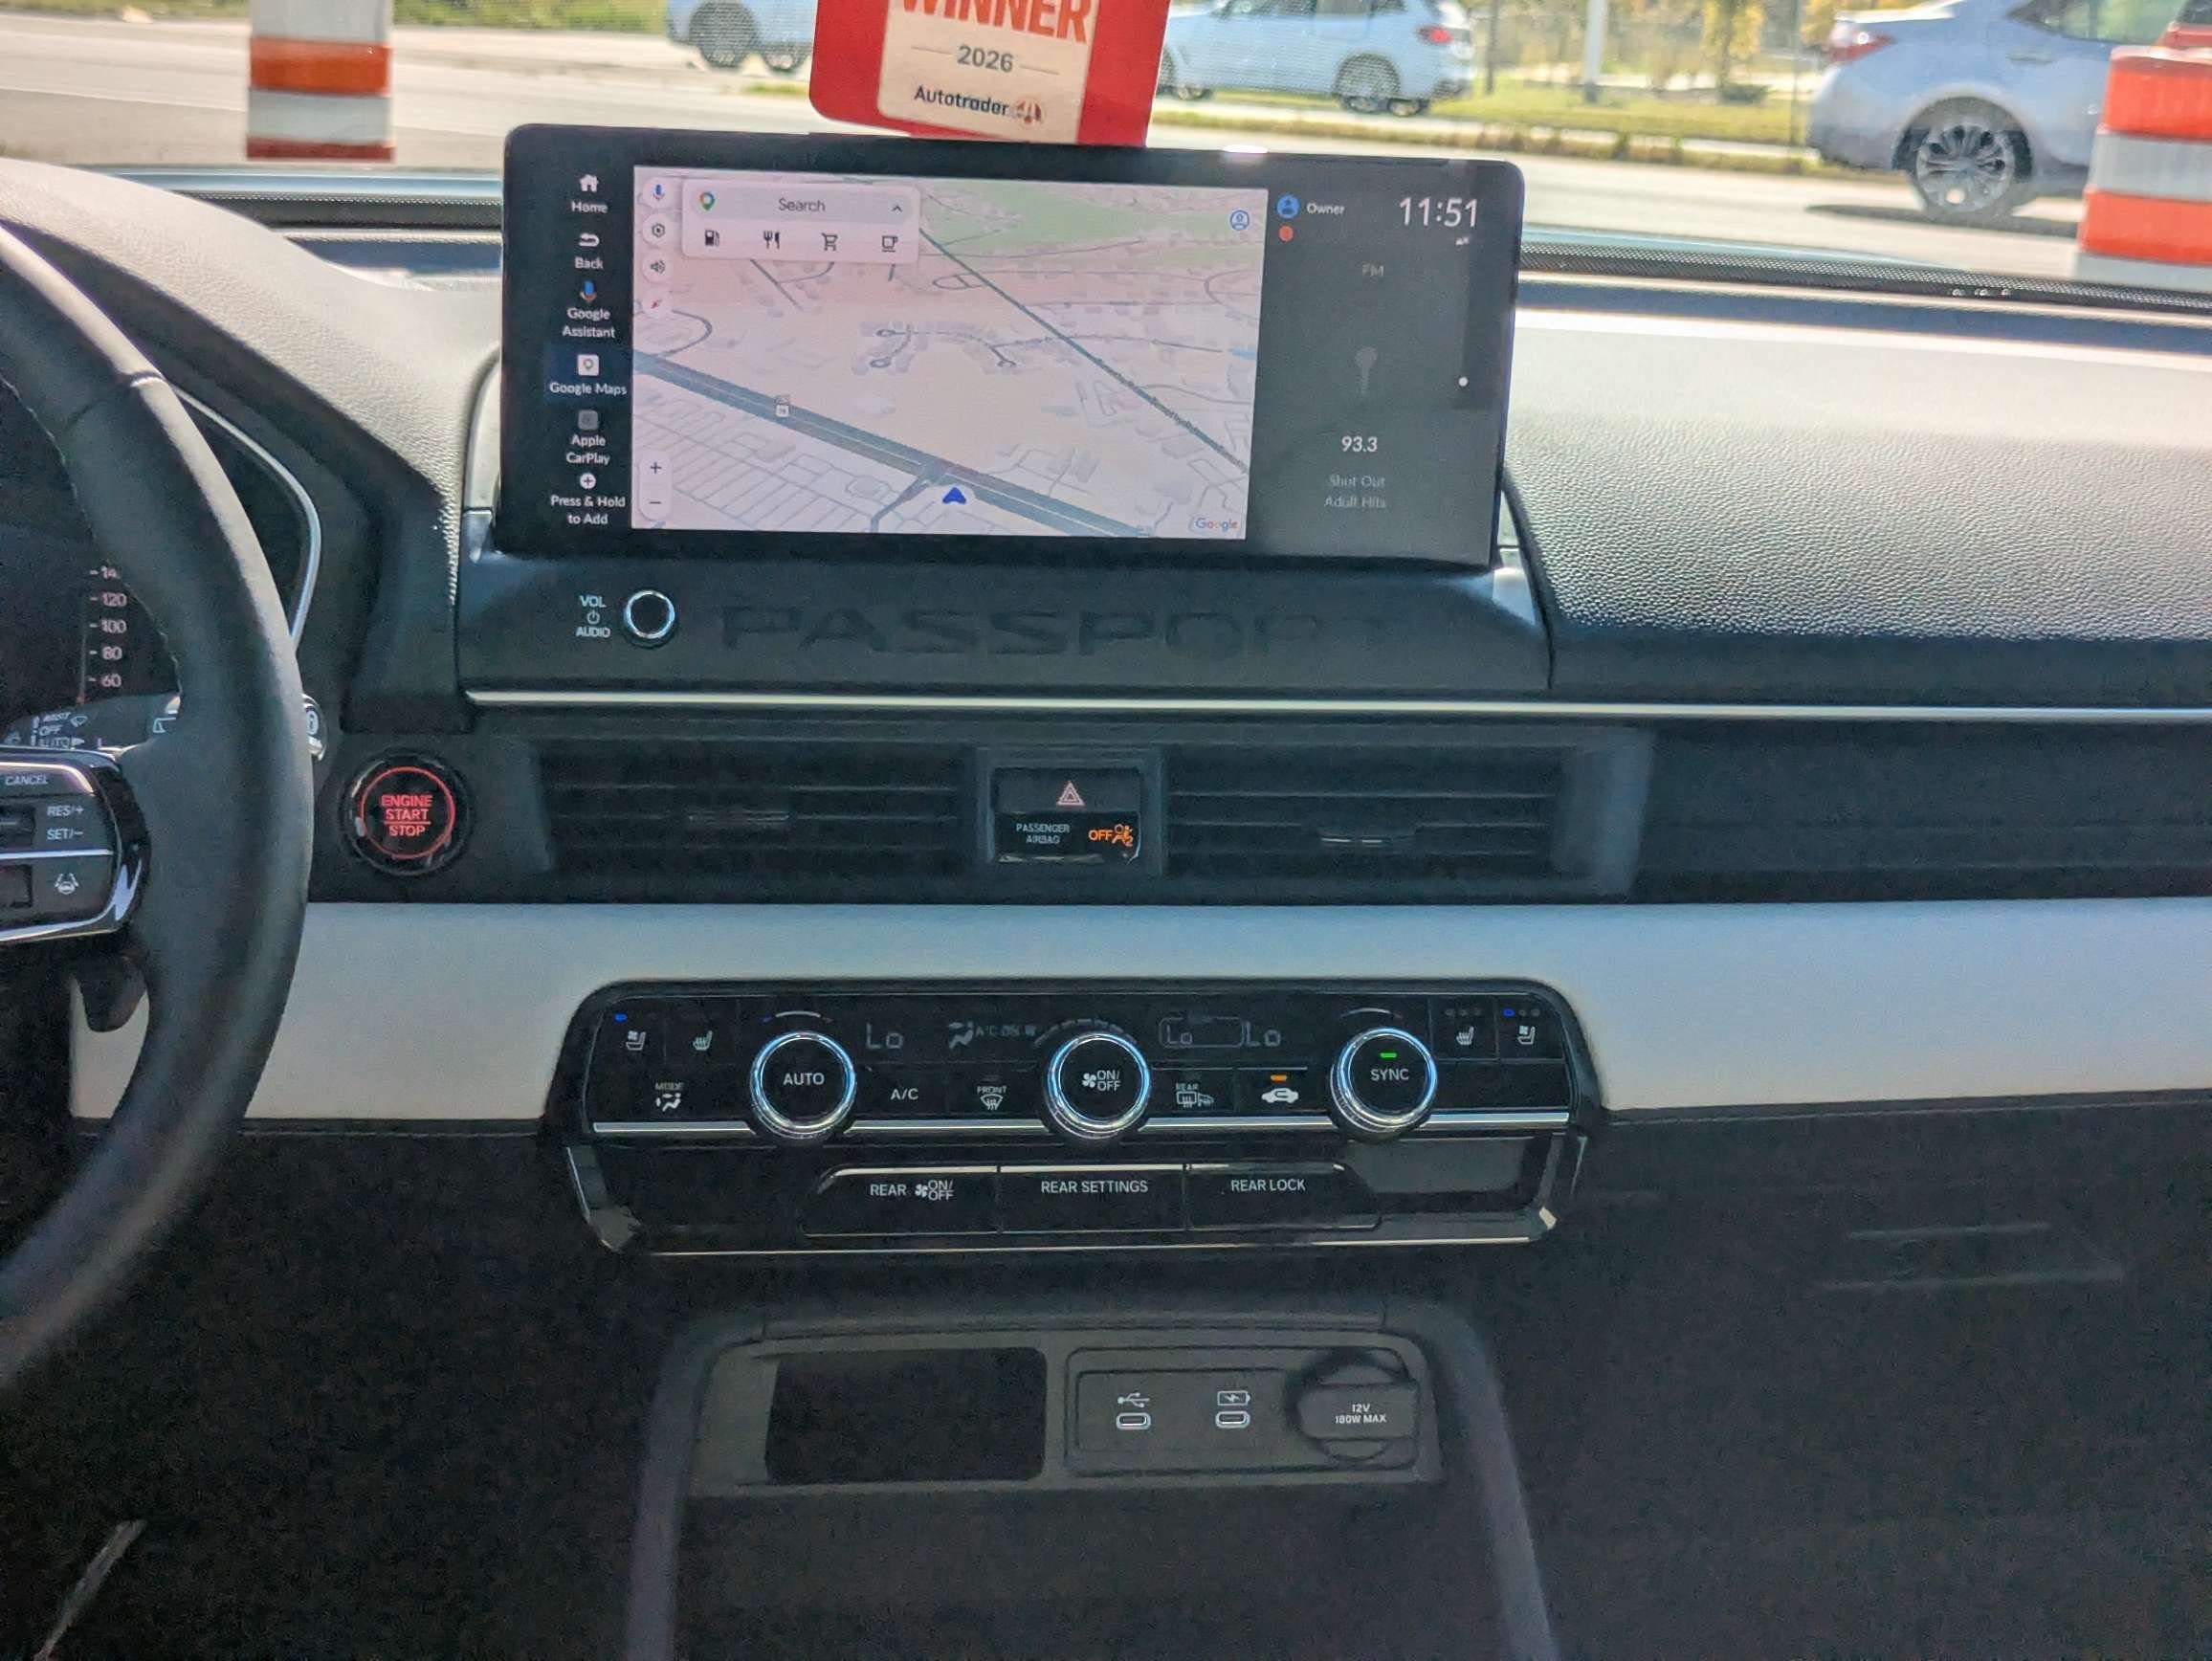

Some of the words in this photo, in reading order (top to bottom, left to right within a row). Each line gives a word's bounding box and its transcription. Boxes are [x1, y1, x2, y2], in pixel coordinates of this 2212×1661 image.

[901, 0, 1091, 44] NER
[958, 44, 1013, 73] 2026
[914, 85, 1009, 117] Autotrader
[571, 201, 608, 213] Home
[778, 198, 826, 212] Search
[1306, 202, 1345, 215] Owner
[1400, 197, 1477, 228] 11:51
[575, 257, 604, 270] Back
[1362, 264, 1384, 277] FM
[566, 307, 610, 321] Google
[563, 325, 615, 338] Assistant
[549, 382, 591, 395] Google
[595, 384, 627, 396] Maps
[571, 434, 606, 448] Apple
[1340, 436, 1378, 453] 93.3
[566, 453, 610, 465] CarPlay
[551, 495, 582, 506] Press
[585, 496, 594, 507] &
[597, 497, 626, 507] Hold
[1324, 495, 1358, 508] Adult
[568, 515, 580, 524] to
[584, 514, 608, 524] Add
[1195, 518, 1238, 531] Google
[101, 592, 127, 607] 120
[579, 594, 607, 608] VOL
[101, 619, 127, 633] 100
[575, 626, 610, 638] AUDIO
[102, 646, 122, 660] 80
[100, 674, 122, 688] 60
[39, 724, 63, 736] OFF
[6, 774, 49, 786] CANCEL
[382, 794, 433, 807] ENGINE
[386, 808, 429, 820] START
[389, 825, 426, 836] STOP
[1016, 823, 1070, 833] PASSENGER
[1026, 835, 1060, 844] AIRBAG
[1088, 830, 1113, 841] OFF
[865, 1022, 903, 1050] Lo
[1166, 1025, 1193, 1045] Lo
[1246, 1020, 1282, 1047] Lo
[783, 1072, 825, 1086] AUTO
[1096, 1070, 1120, 1080] ON/
[1370, 1069, 1409, 1082] SYNC
[977, 1085, 1006, 1095] FRONT
[1096, 1080, 1120, 1091] OFF
[1176, 1082, 1199, 1091] REAR
[890, 1088, 918, 1100] A/C
[870, 1183, 906, 1196] REAR
[928, 1180, 954, 1190] ON/
[1041, 1181, 1077, 1194] REAR
[1081, 1180, 1148, 1193] SETTINGS
[1231, 1179, 1265, 1192] REAR
[1269, 1178, 1306, 1192] LOCK
[928, 1190, 954, 1202] OFF
[1352, 1403, 1370, 1412] 12V
[1335, 1415, 1361, 1424] 180W
[1363, 1413, 1387, 1423] MAX
